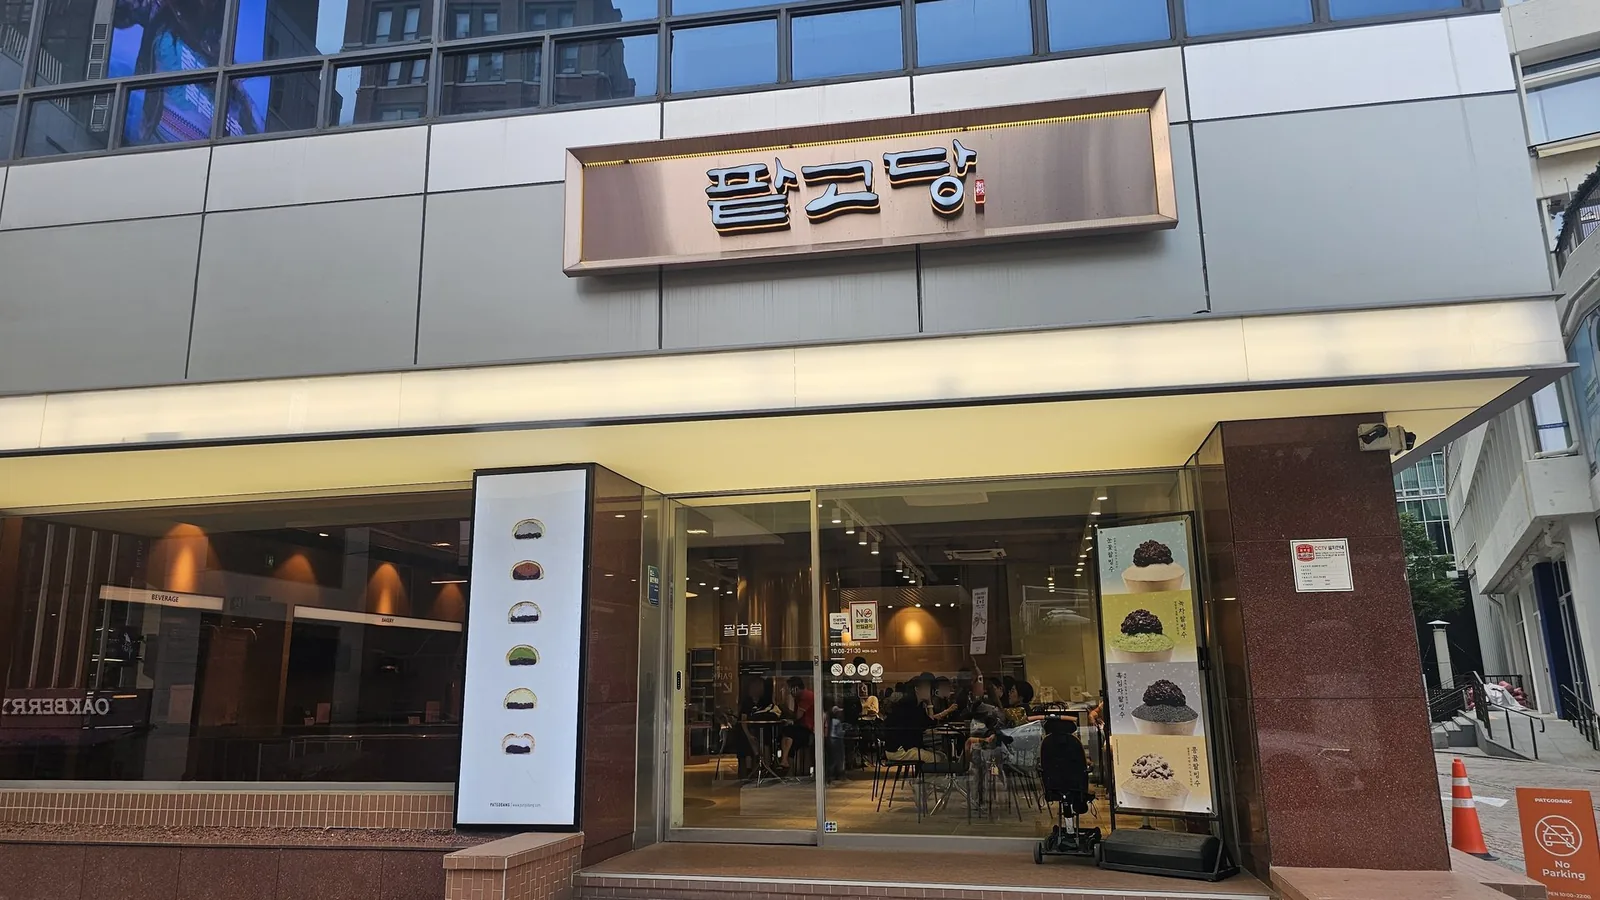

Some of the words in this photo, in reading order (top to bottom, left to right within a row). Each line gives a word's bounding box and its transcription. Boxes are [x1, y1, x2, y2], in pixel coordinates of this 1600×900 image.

[705, 138, 977, 233] 팥고당
[151, 593, 179, 603] BEVERAGE
[1177, 600, 1187, 638] 녹차팥빙수
[1116, 672, 1126, 718] 흑임자팥빙수
[1554, 860, 1571, 869] No
[1542, 868, 1586, 881] Parking
[1559, 891, 1592, 899] 10:00-22:00
